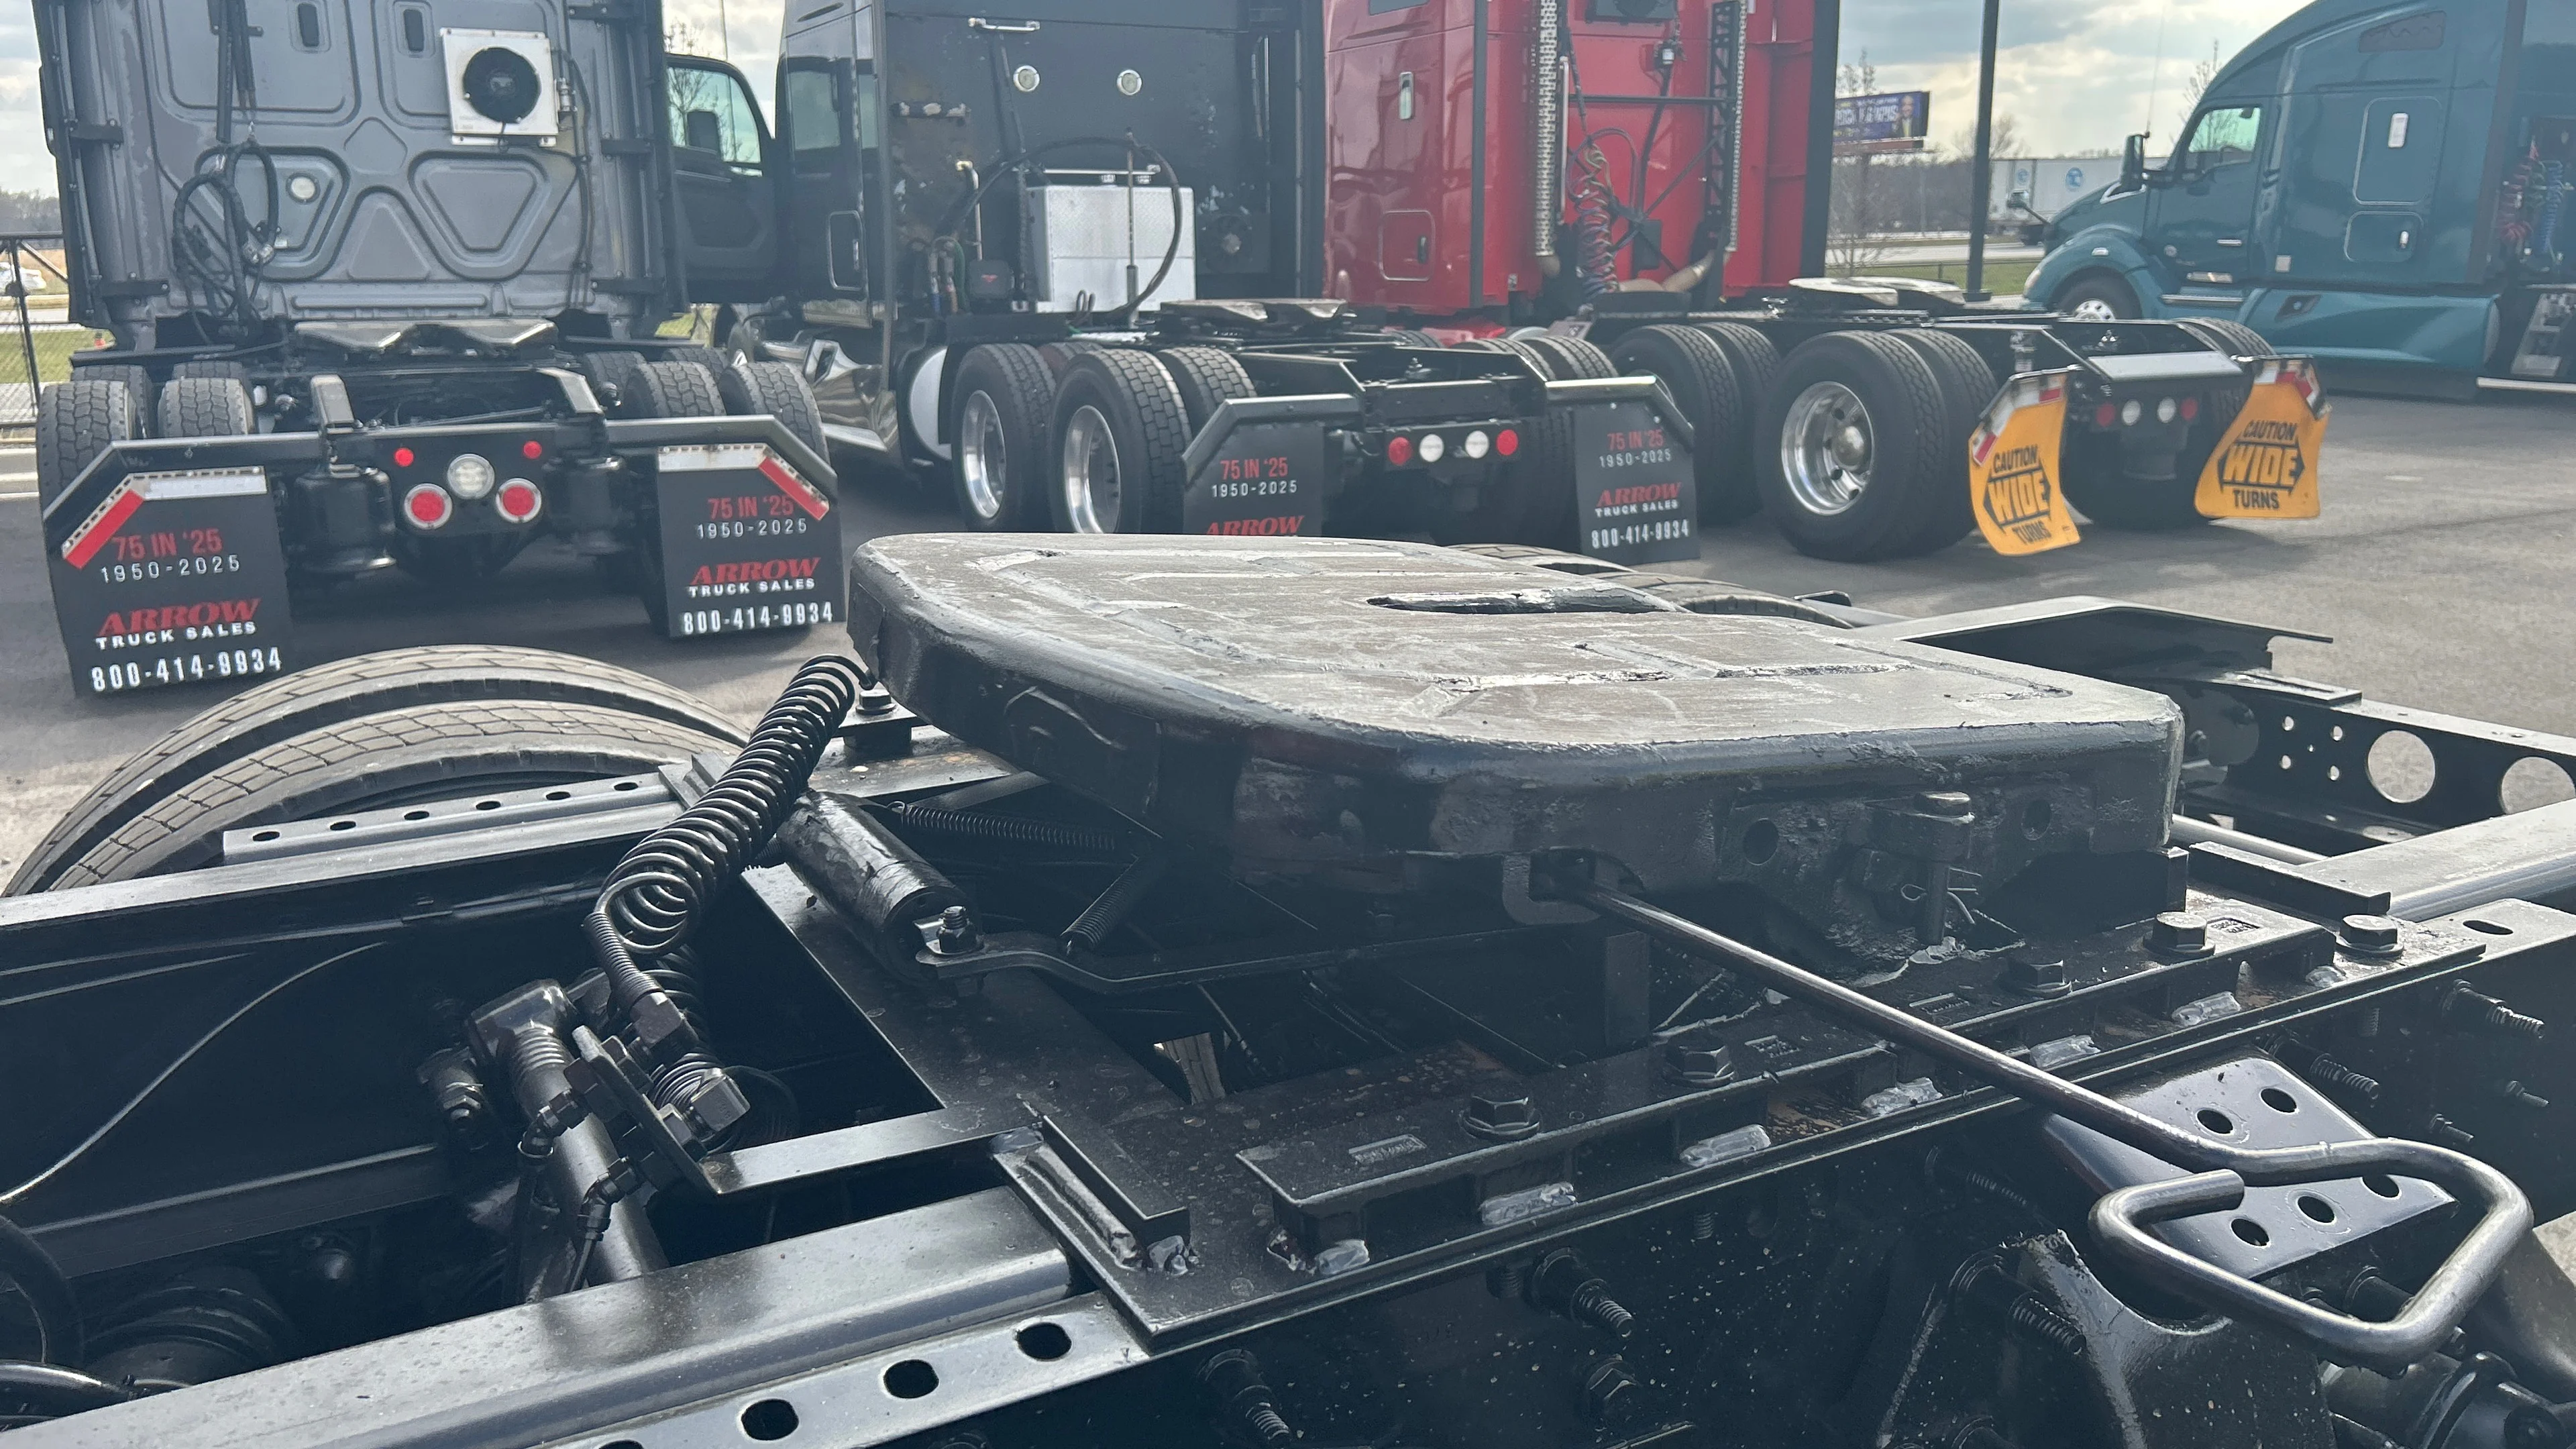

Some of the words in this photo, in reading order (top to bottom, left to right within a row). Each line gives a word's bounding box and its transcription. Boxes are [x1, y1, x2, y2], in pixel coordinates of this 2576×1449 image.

[1607, 432, 1625, 451] 75
[1629, 431, 1642, 449] IN
[2244, 420, 2298, 440] CAUTION
[1220, 460, 1240, 480] 75
[1244, 459, 1259, 479] IN
[1600, 448, 1672, 468] 1950-2025
[1994, 445, 2037, 473] CAUTION
[2223, 443, 2298, 485] WIDE
[1212, 480, 1297, 498] 1950-2025
[1597, 482, 1682, 508] ARROW
[1988, 470, 2049, 524] WIDE
[2234, 490, 2279, 509] TURNS
[708, 498, 733, 521] 75
[738, 496, 758, 518] IN
[1595, 504, 1638, 518] TRUCK
[1642, 499, 1678, 513] SALES
[696, 517, 807, 539] 1950-2025
[1207, 516, 1304, 535] ARROW
[2012, 520, 2051, 545] TURNS
[111, 535, 146, 561] 75
[151, 533, 177, 557] IN
[101, 554, 239, 584] 1950-2025
[689, 557, 821, 586] ARROW
[688, 582, 750, 598] TRUCK
[759, 578, 815, 593] SALES
[97, 598, 260, 636] ARROW
[683, 601, 833, 635] 800-414-9934
[95, 629, 174, 650] TRUCK
[185, 621, 256, 640] SALES
[91, 646, 282, 692] 800-414-9934
